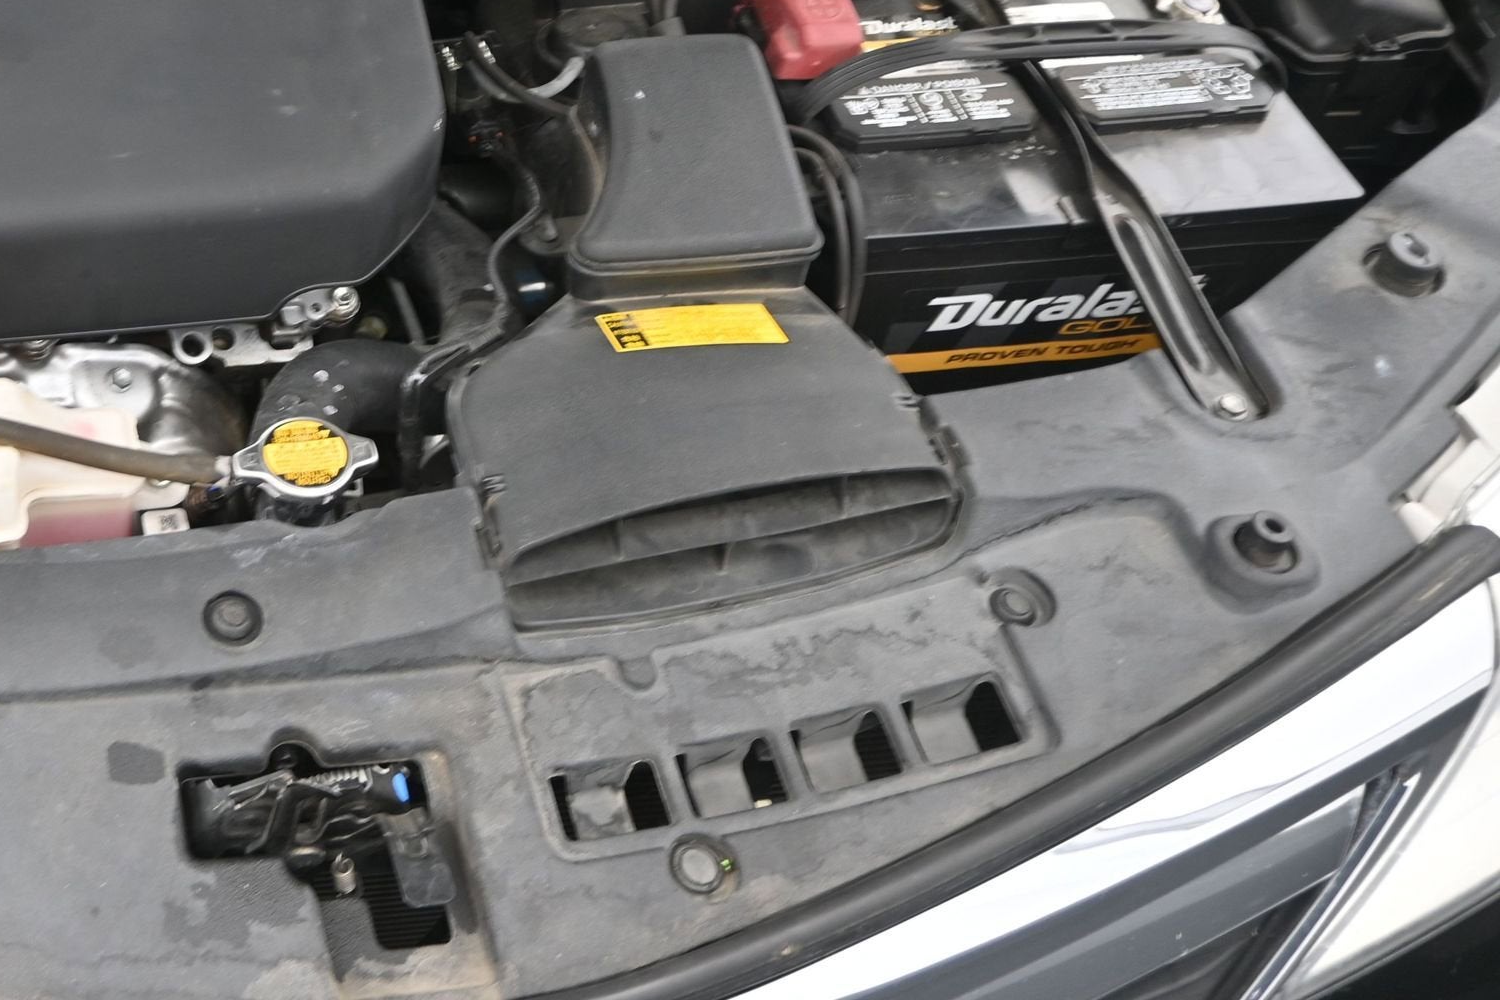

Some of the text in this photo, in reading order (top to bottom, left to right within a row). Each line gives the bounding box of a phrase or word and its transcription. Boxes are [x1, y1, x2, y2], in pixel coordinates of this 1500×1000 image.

[858, 16, 958, 35] Duralast
[925, 275, 1207, 332] Durala
[1058, 316, 1150, 335] GOL
[946, 338, 1142, 364] PROVEN TOUGH
